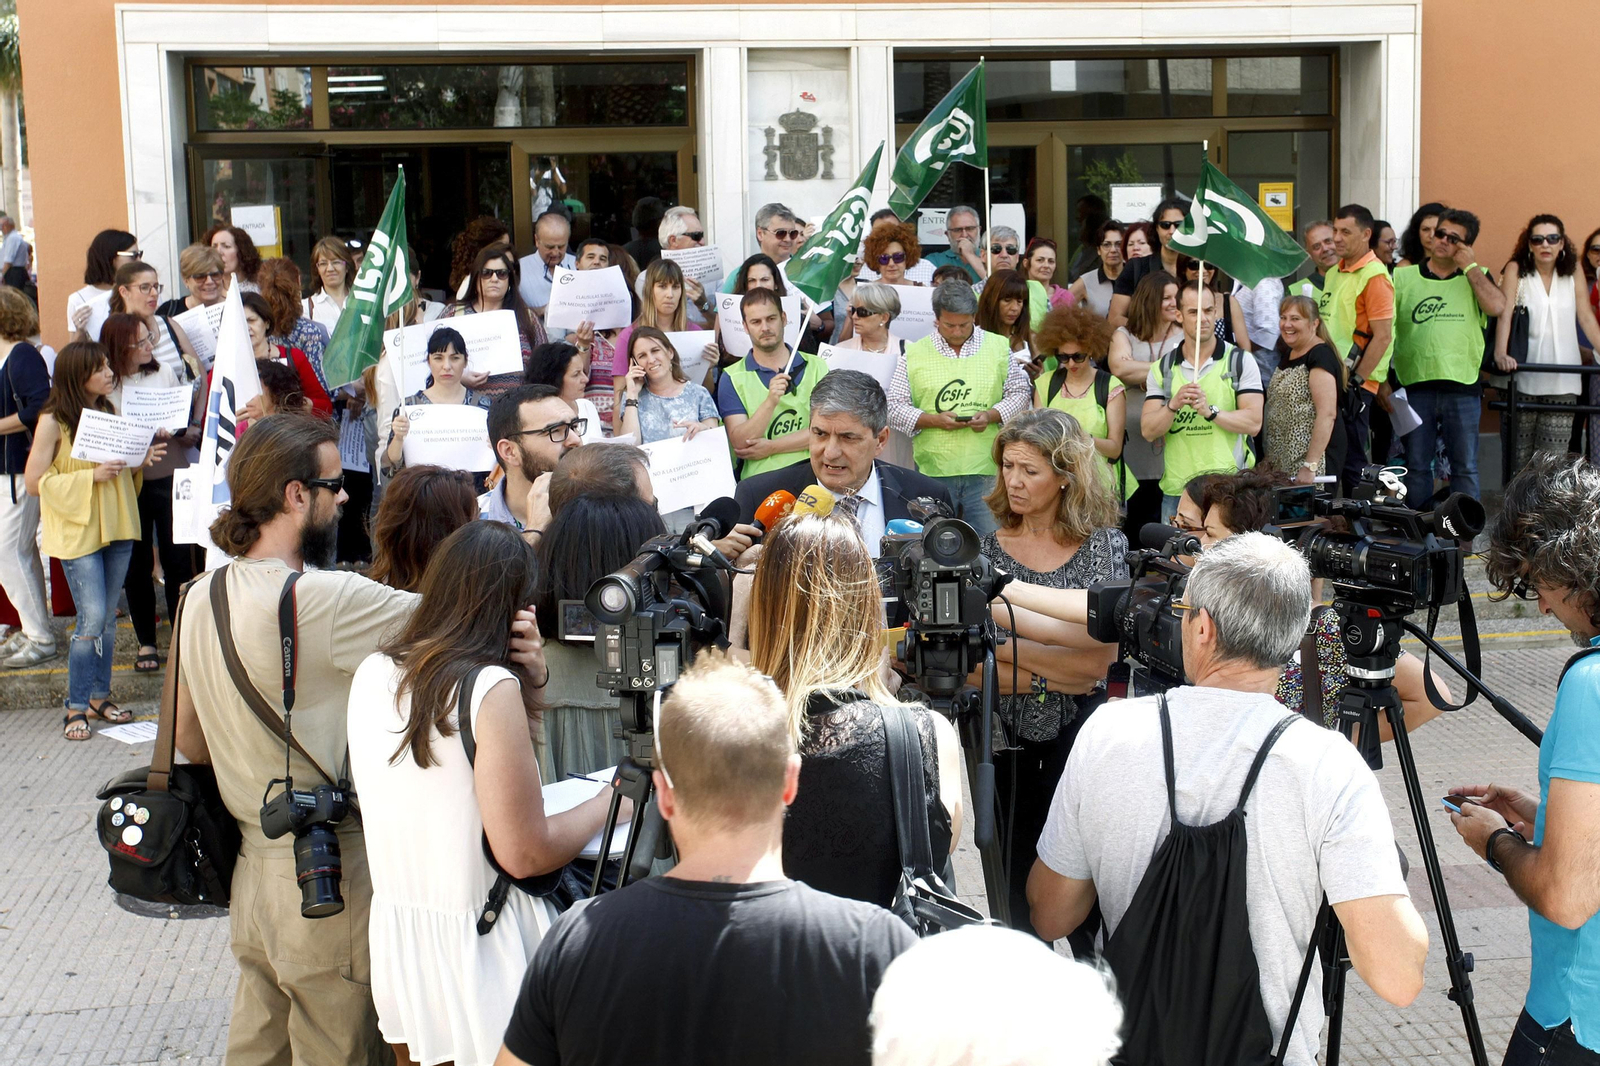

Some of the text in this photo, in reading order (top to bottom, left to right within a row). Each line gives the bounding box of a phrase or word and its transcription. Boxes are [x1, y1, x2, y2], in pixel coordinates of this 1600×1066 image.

[922, 216, 946, 225] ENTR
[466, 335, 502, 345] SPECIALIZACIÓN
[282, 636, 292, 678] Canon
